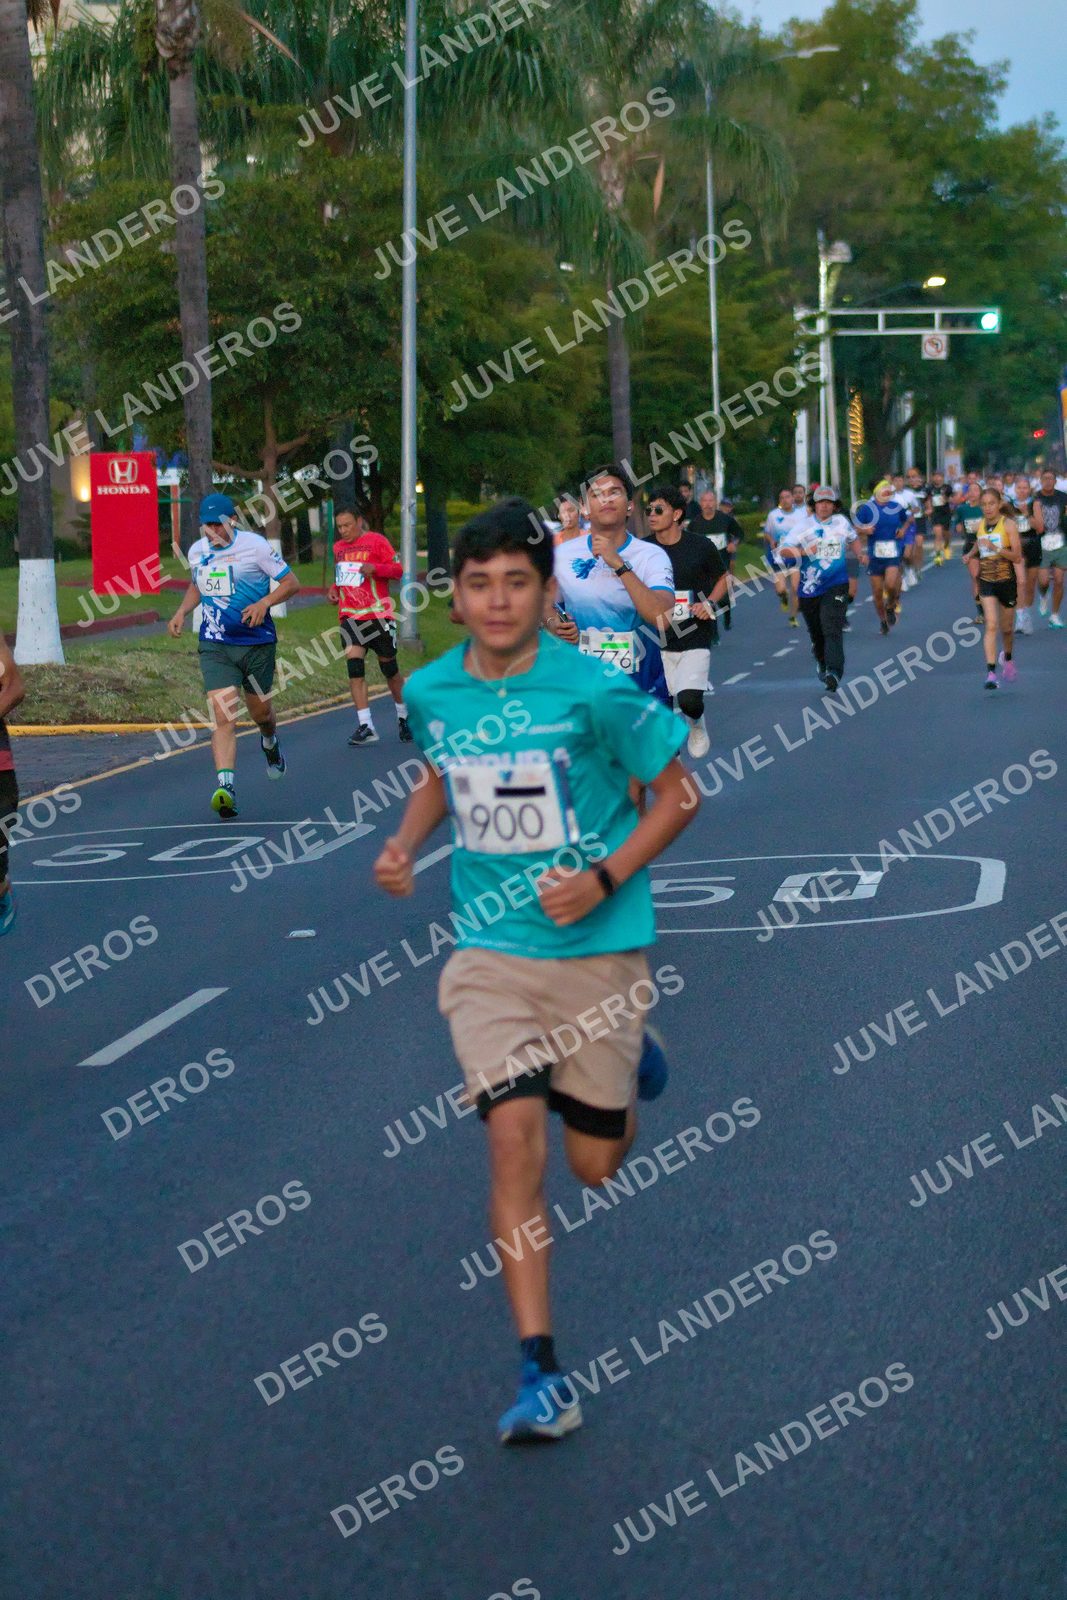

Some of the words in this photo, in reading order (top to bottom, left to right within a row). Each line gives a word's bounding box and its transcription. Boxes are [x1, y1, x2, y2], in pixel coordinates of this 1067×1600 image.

[97, 485, 150, 495] HONDA
[206, 579, 221, 591] 54
[470, 804, 544, 841] 900
[33, 837, 266, 866] 50
